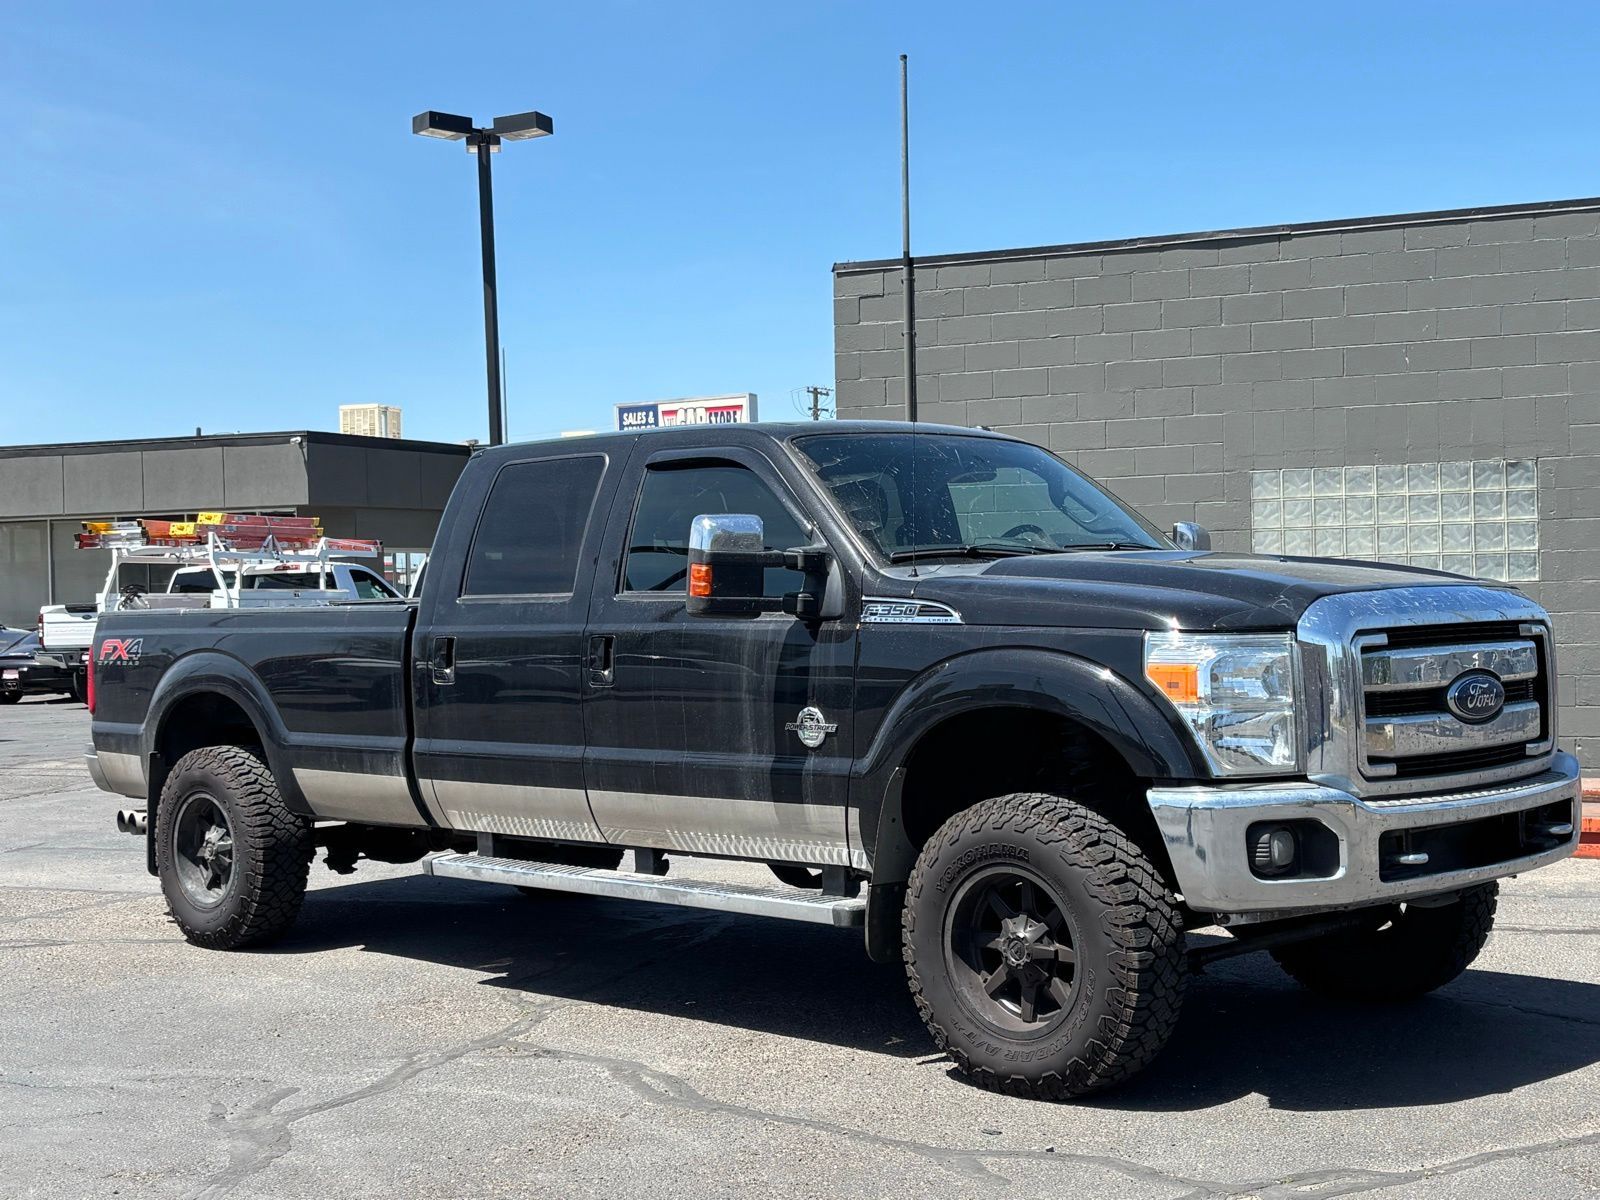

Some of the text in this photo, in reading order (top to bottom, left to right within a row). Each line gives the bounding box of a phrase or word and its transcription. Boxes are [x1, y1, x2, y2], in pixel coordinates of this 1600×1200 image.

[623, 411, 655, 425] SALES &
[708, 411, 738, 424] STORE
[99, 638, 143, 661] FX4
[1467, 683, 1497, 709] Ford
[936, 842, 1030, 893] YOKOHAMA
